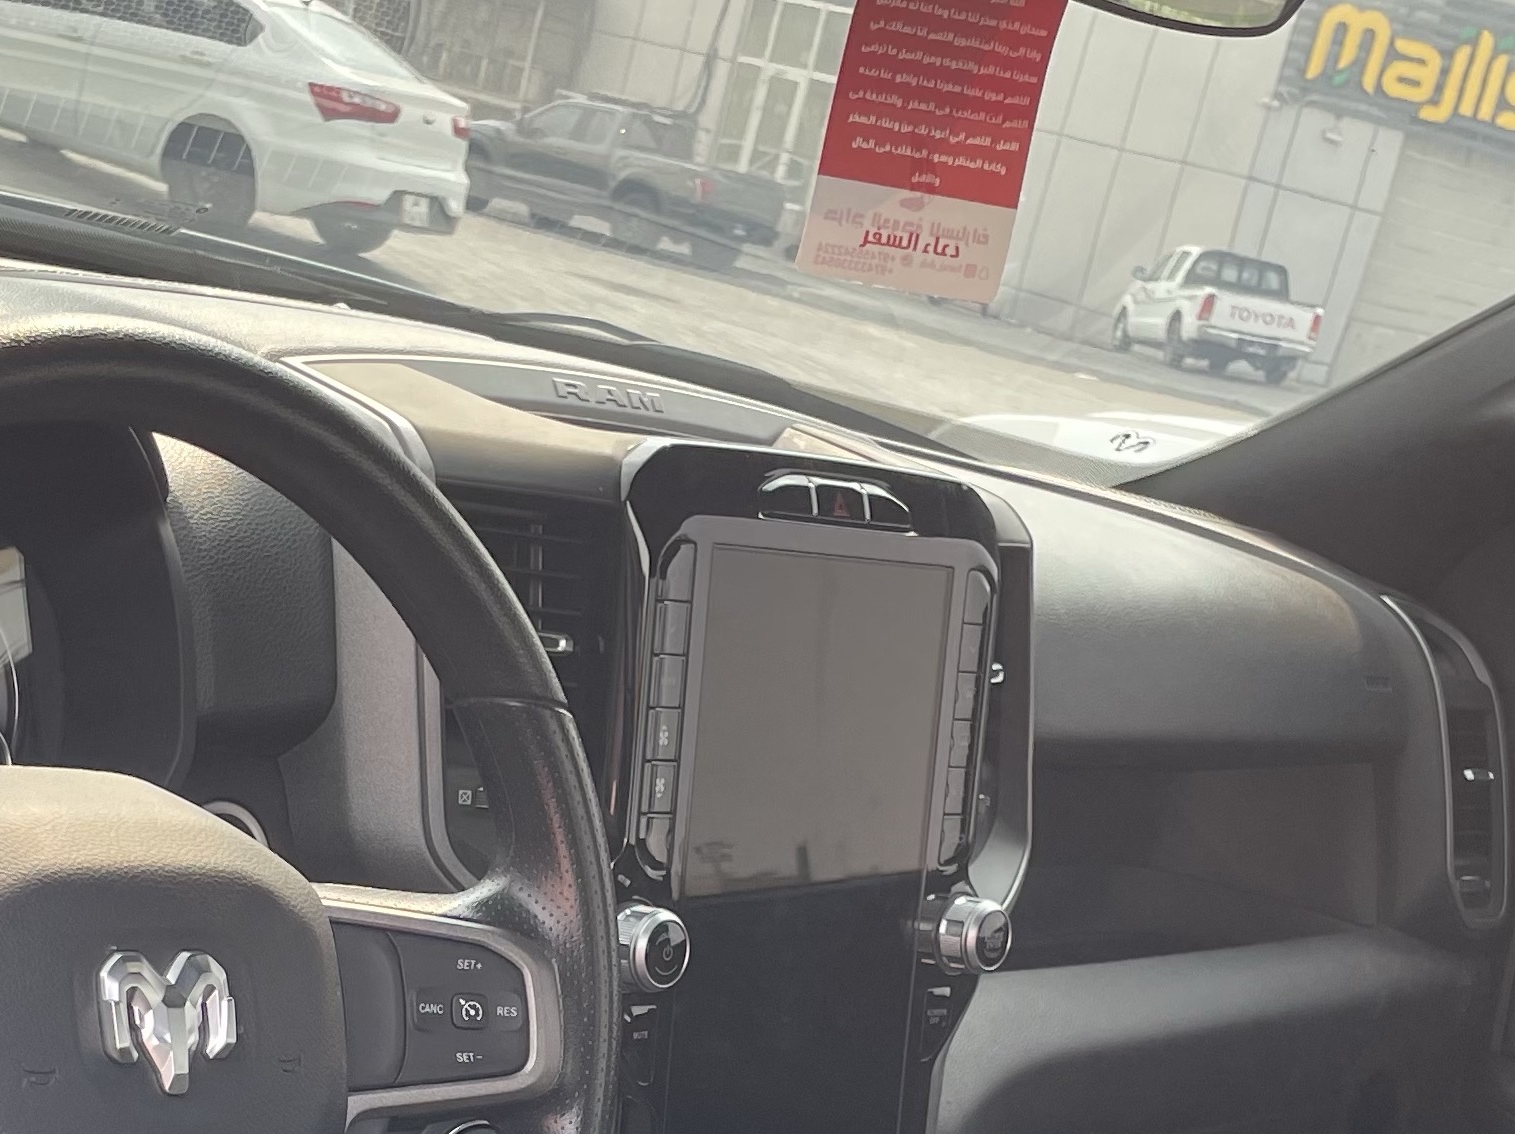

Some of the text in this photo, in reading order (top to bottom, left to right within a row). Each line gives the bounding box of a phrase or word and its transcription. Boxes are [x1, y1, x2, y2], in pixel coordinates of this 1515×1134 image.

[859, 226, 960, 258] دعاء السفر
[1229, 304, 1296, 330] TOYOTA
[552, 377, 665, 413] RAM
[419, 1002, 444, 1014] CANC
[496, 1006, 518, 1018] RES
